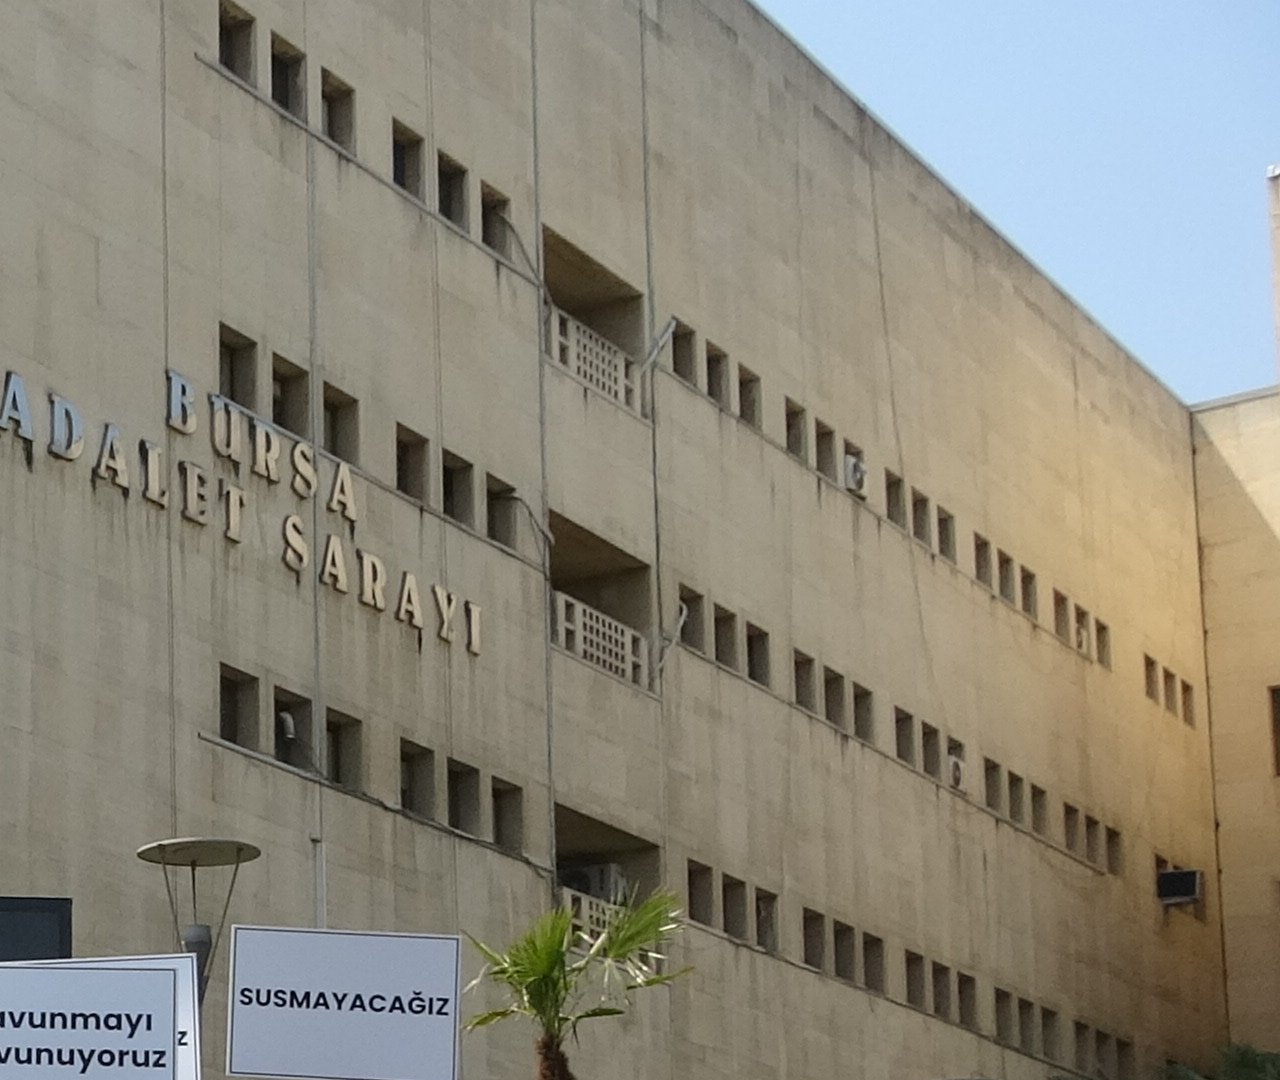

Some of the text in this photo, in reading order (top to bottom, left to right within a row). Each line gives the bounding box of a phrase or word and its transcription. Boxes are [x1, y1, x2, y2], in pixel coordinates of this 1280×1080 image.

[165, 368, 357, 522] BURSA
[283, 514, 482, 656] SARAYI
[239, 987, 449, 1016] SUSMAYACAĞIZ
